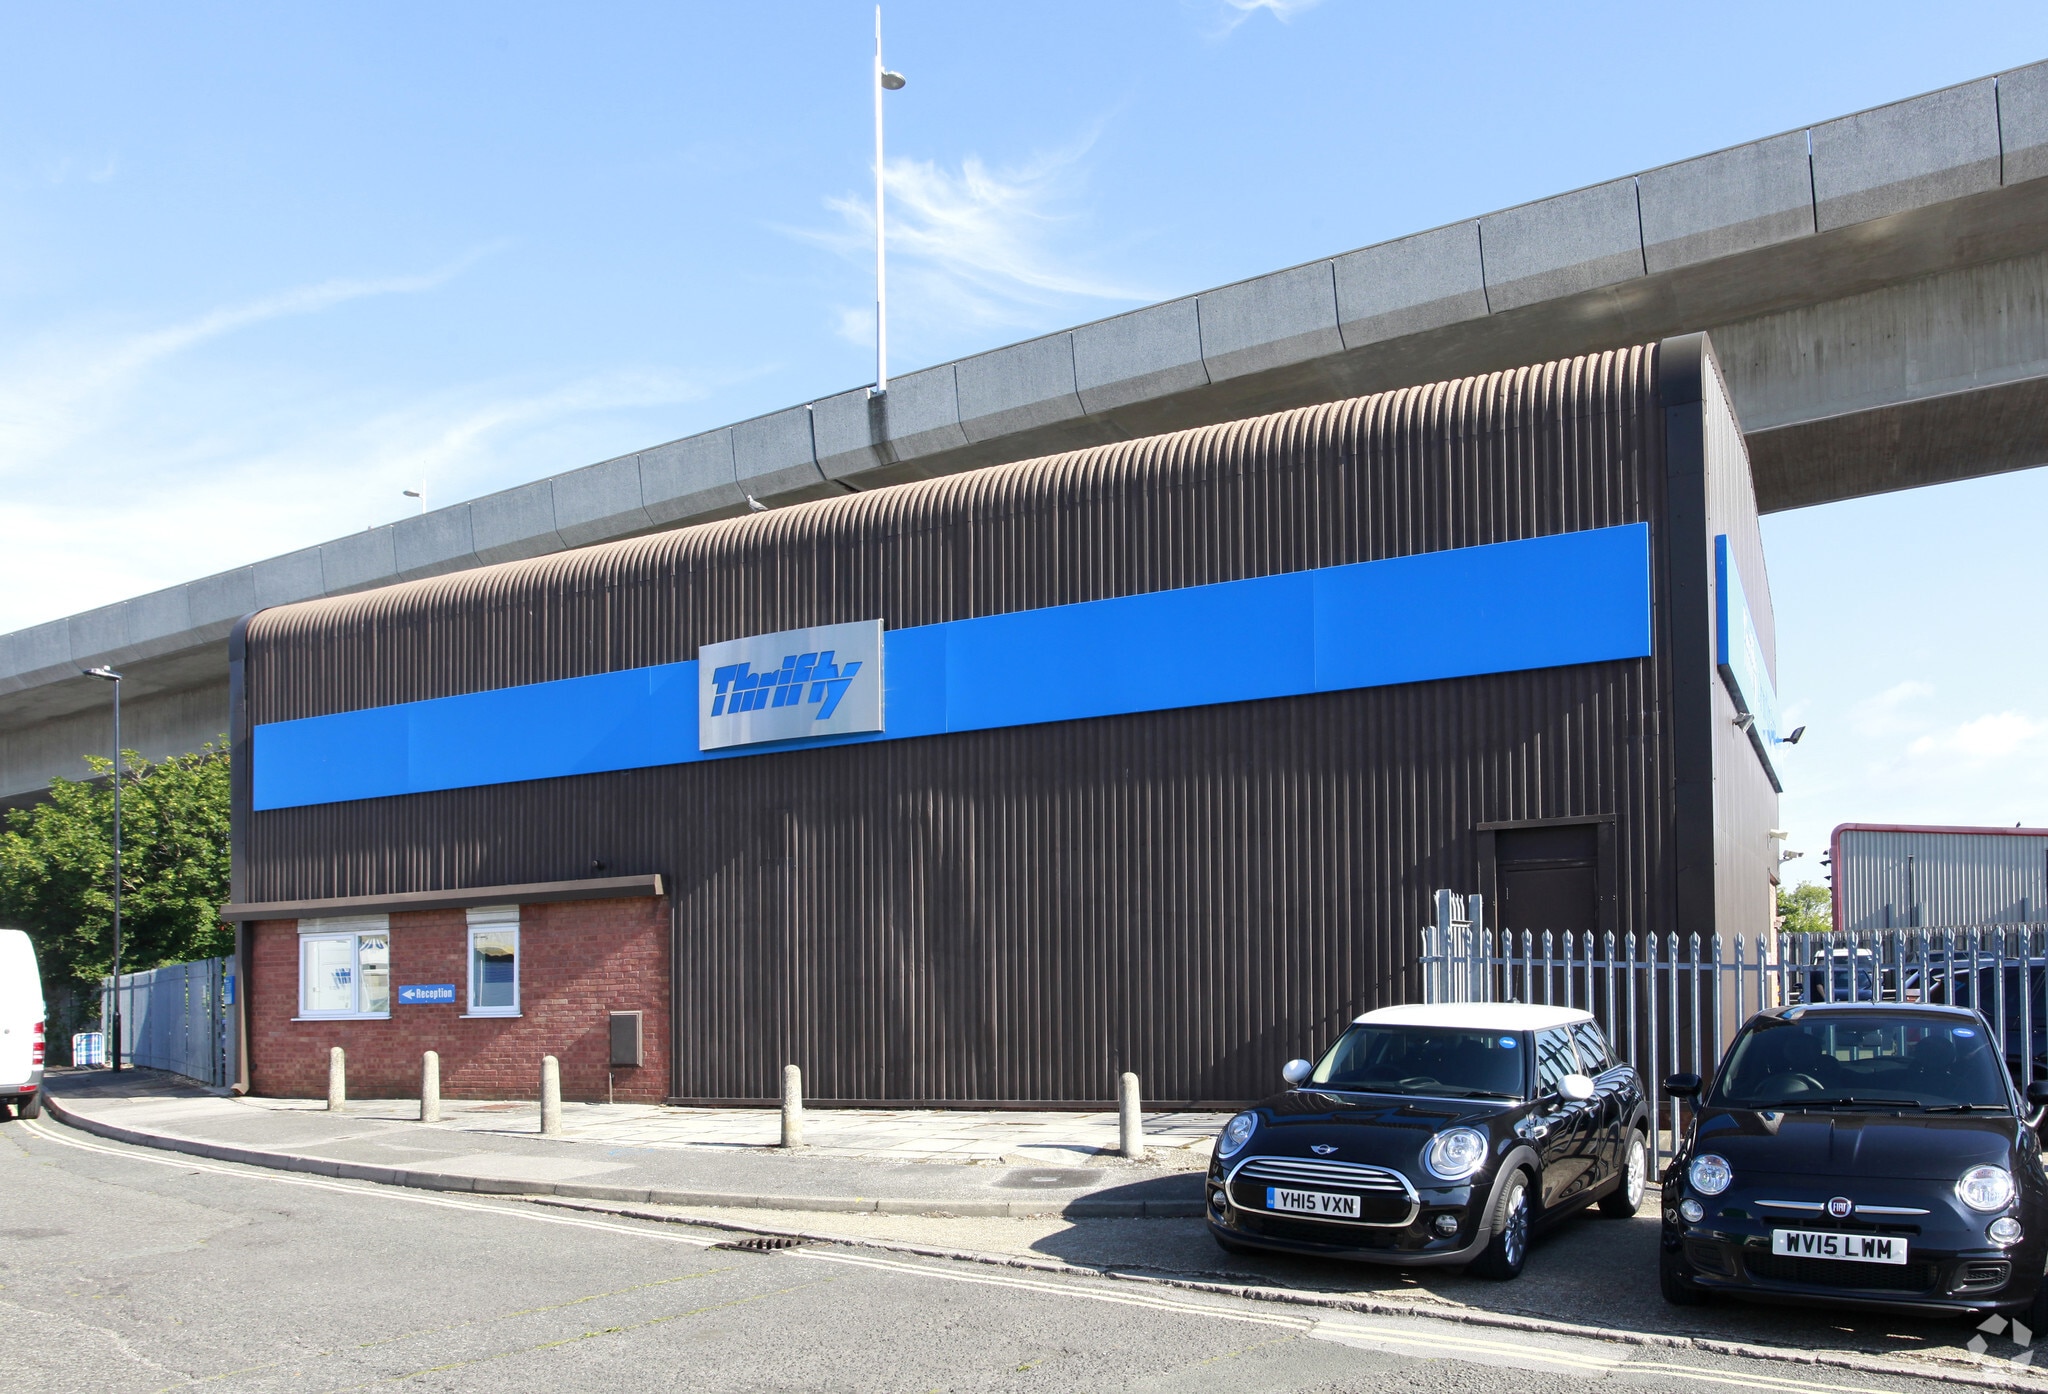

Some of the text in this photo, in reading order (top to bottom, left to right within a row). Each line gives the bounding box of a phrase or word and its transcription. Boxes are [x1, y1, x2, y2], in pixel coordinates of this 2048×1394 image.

[711, 650, 863, 720] Thrifty
[416, 988, 453, 999] Reception
[1281, 1191, 1354, 1214] YH15 VXN
[1833, 1202, 1847, 1212] FIAT
[1786, 1232, 1891, 1259] WV15 LWM
